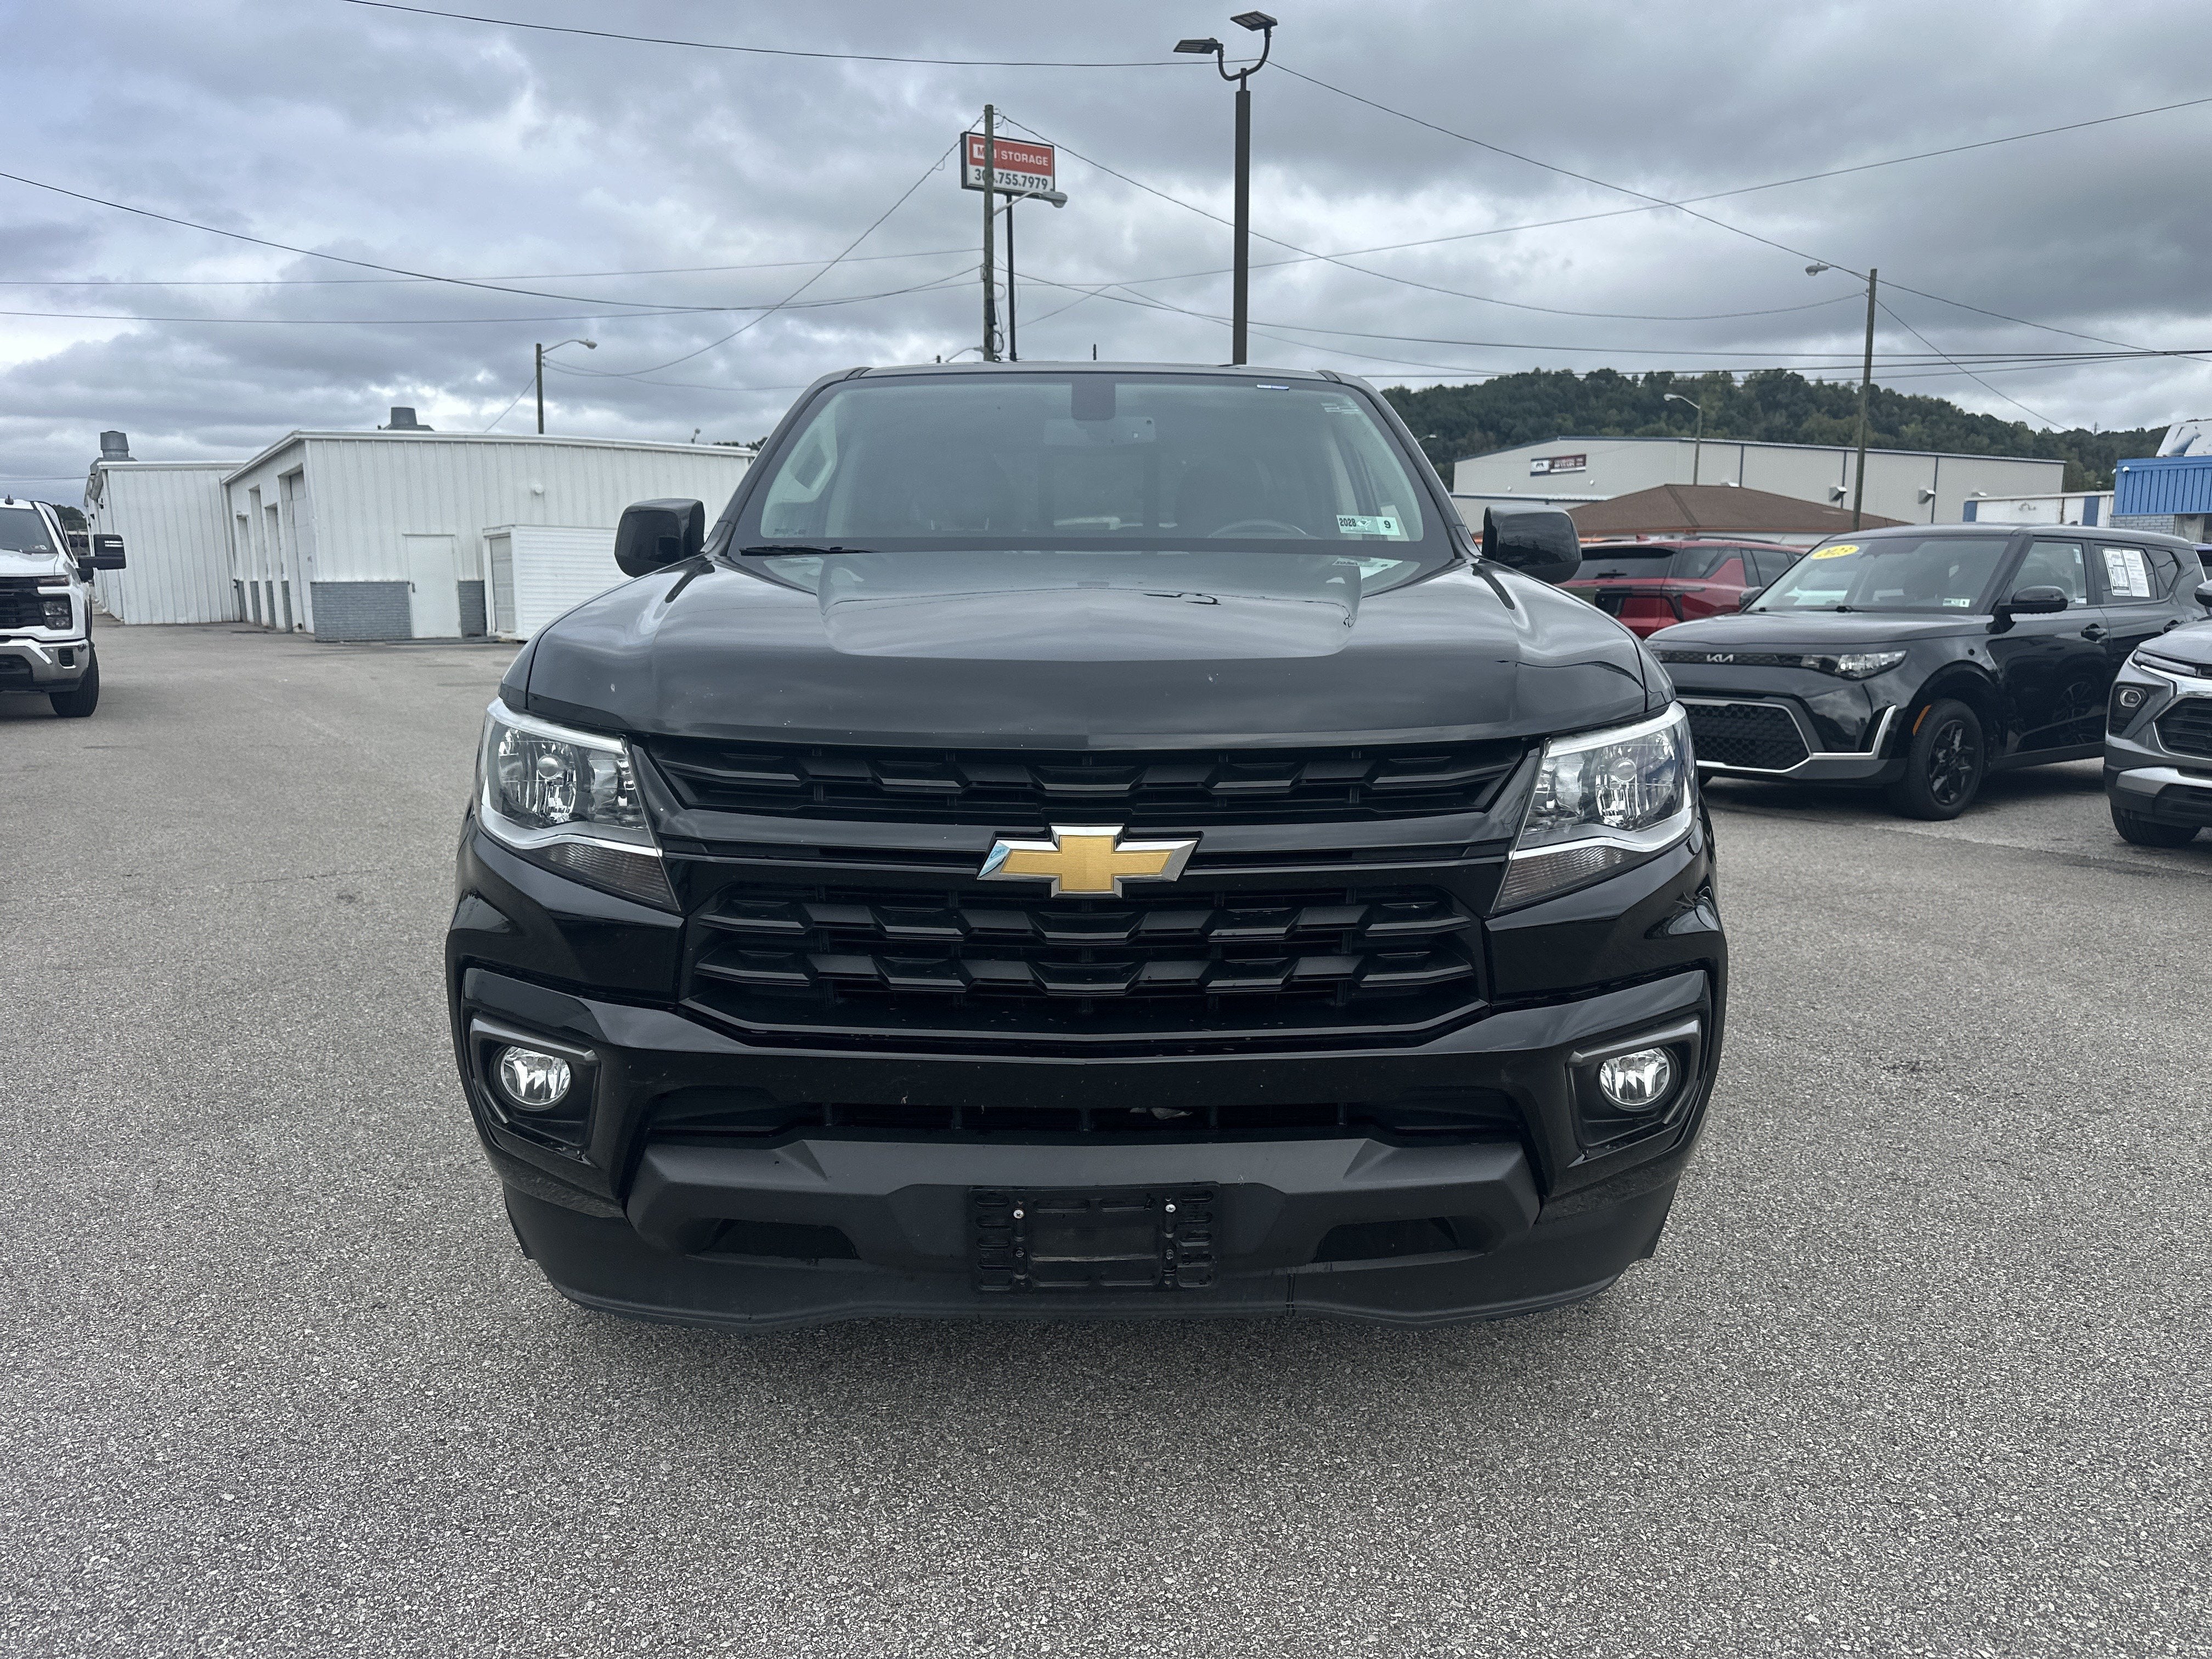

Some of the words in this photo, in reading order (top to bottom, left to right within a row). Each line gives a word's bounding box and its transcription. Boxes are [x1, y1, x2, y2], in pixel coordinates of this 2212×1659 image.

[1001, 150, 1048, 166] STORAGE
[1339, 518, 1357, 527] 2028
[1384, 520, 1391, 529] 9
